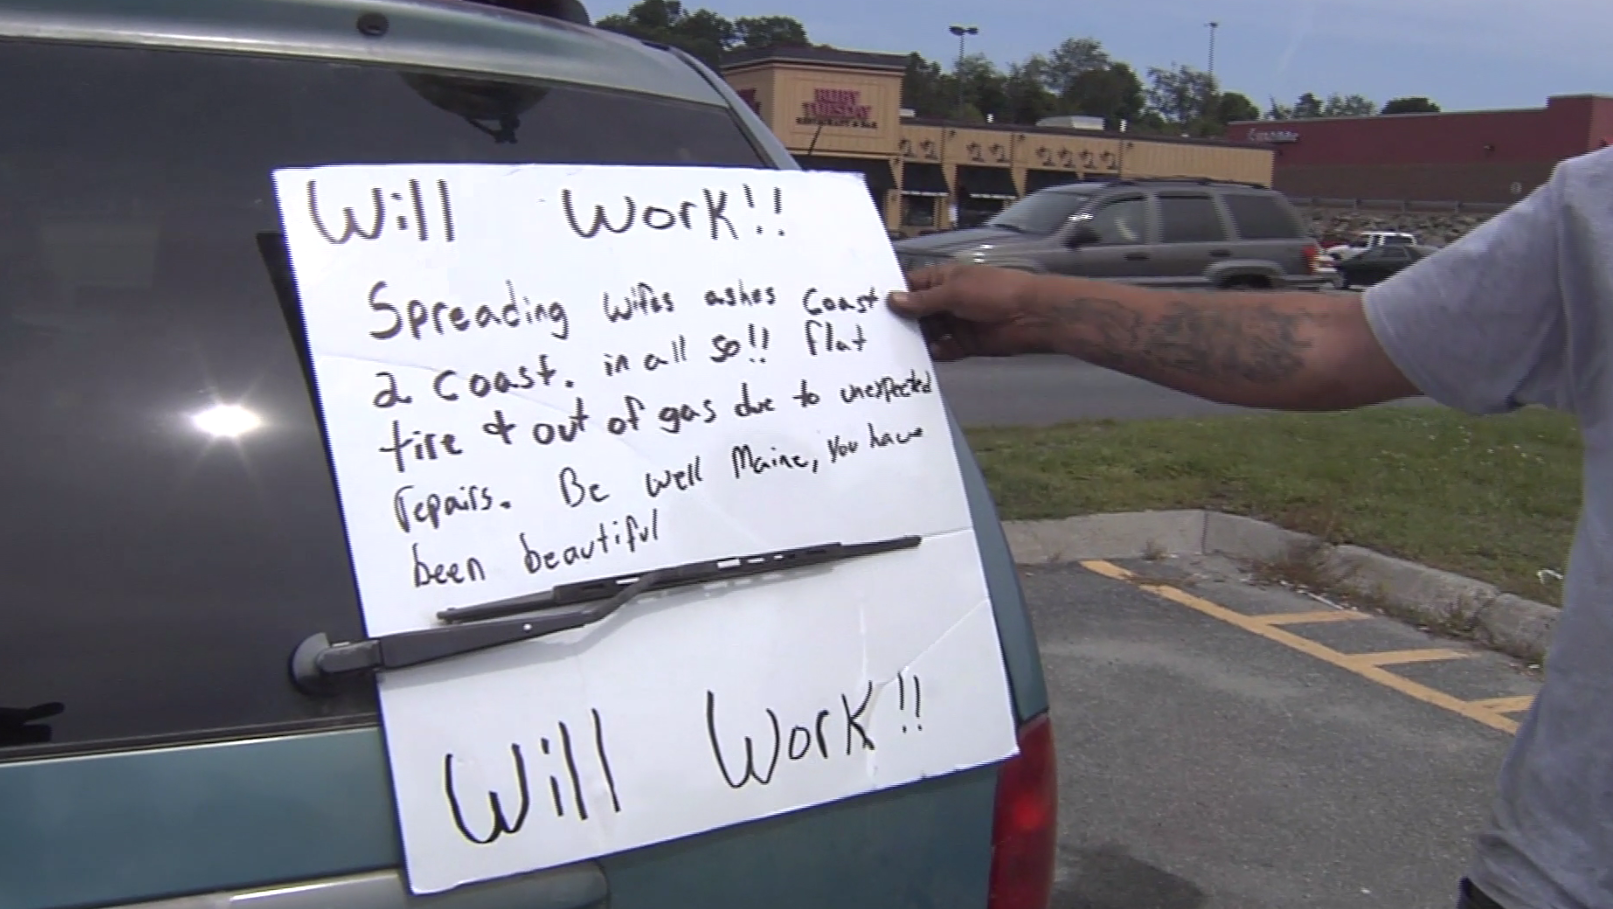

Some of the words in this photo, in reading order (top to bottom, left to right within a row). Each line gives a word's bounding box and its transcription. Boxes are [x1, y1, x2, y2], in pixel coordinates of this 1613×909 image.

[802, 102, 871, 119] TUESDAY
[307, 180, 455, 244] Will
[368, 280, 569, 340] Spreading
[704, 280, 776, 307] ashes
[604, 353, 630, 376] in
[643, 335, 687, 371] all
[379, 420, 463, 473] tire
[532, 397, 590, 446] out
[607, 395, 646, 436] of
[658, 399, 717, 434] gas
[734, 382, 775, 418] due
[792, 379, 820, 408] to
[559, 466, 610, 508] Be
[732, 444, 818, 479] Maine,
[412, 542, 485, 588] been
[519, 508, 658, 574] beautiful
[445, 708, 621, 844] Will
